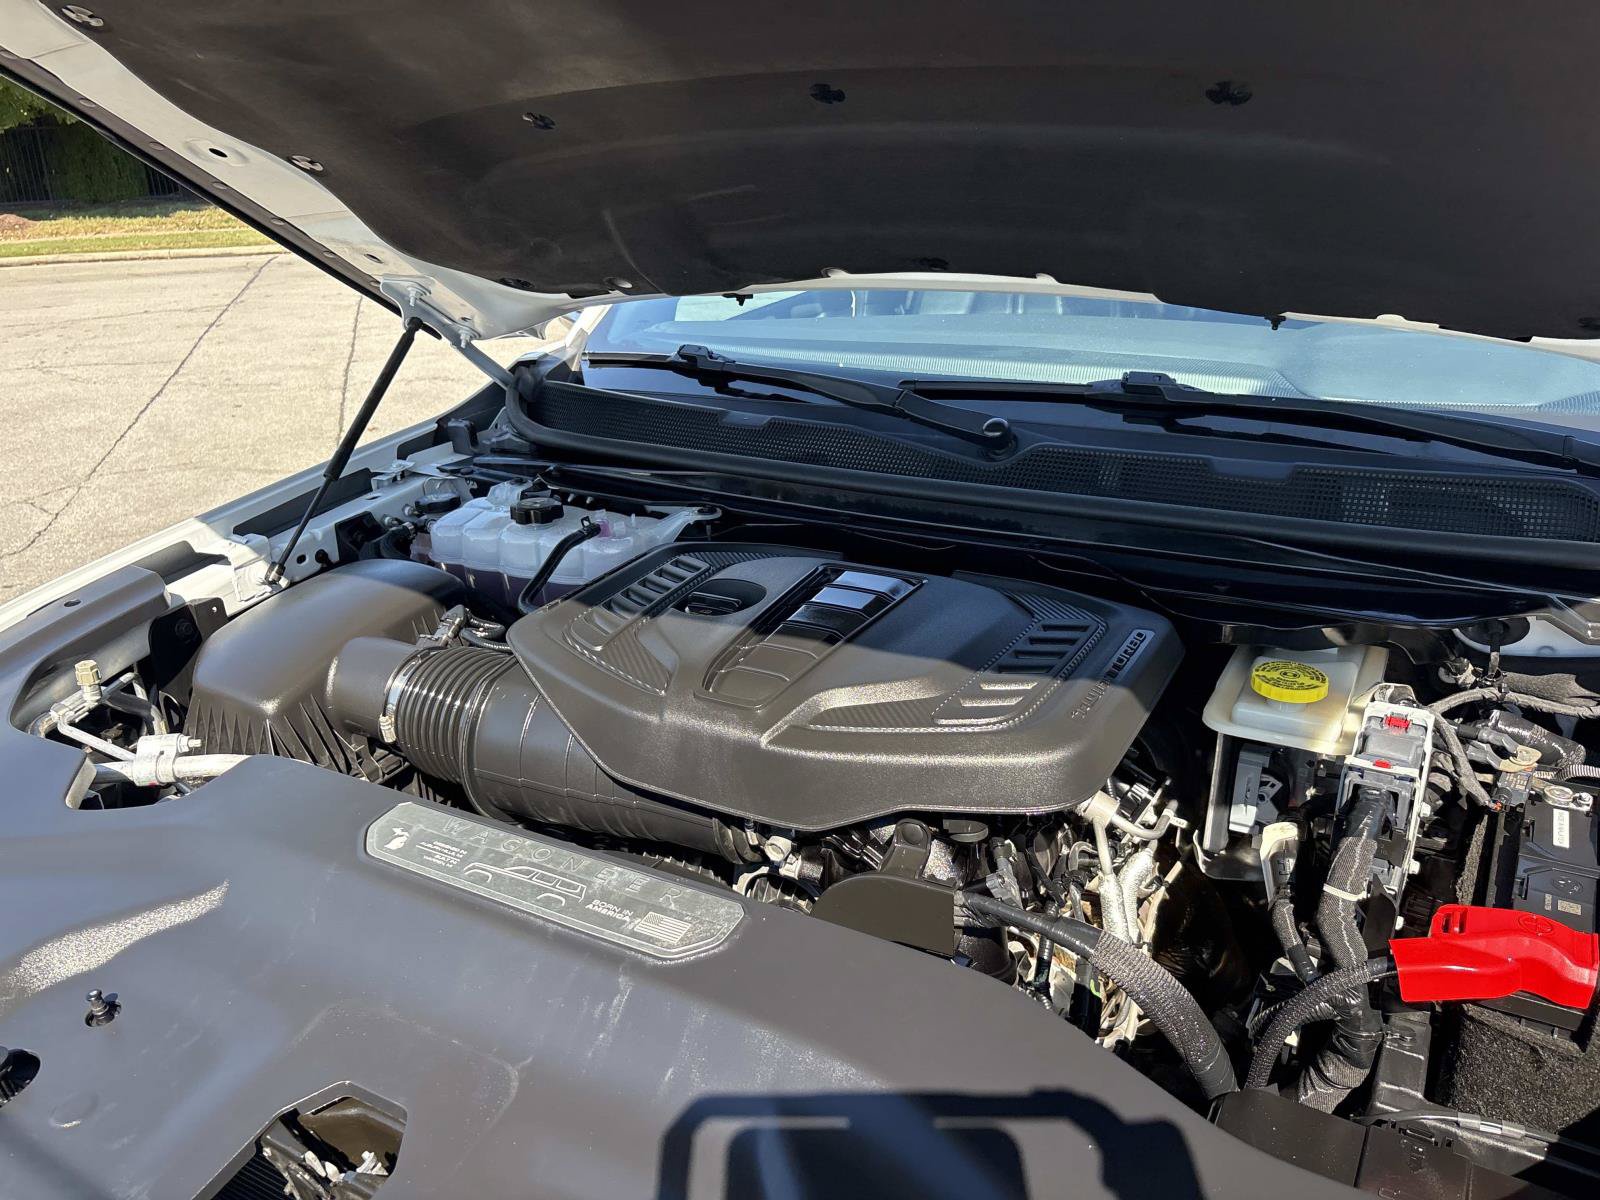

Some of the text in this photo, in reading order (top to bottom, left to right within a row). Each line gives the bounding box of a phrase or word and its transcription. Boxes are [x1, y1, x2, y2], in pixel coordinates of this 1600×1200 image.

[442, 815, 686, 912] WAGONEER
[584, 903, 631, 922] AMERICA
[591, 899, 634, 917] BORN IN
